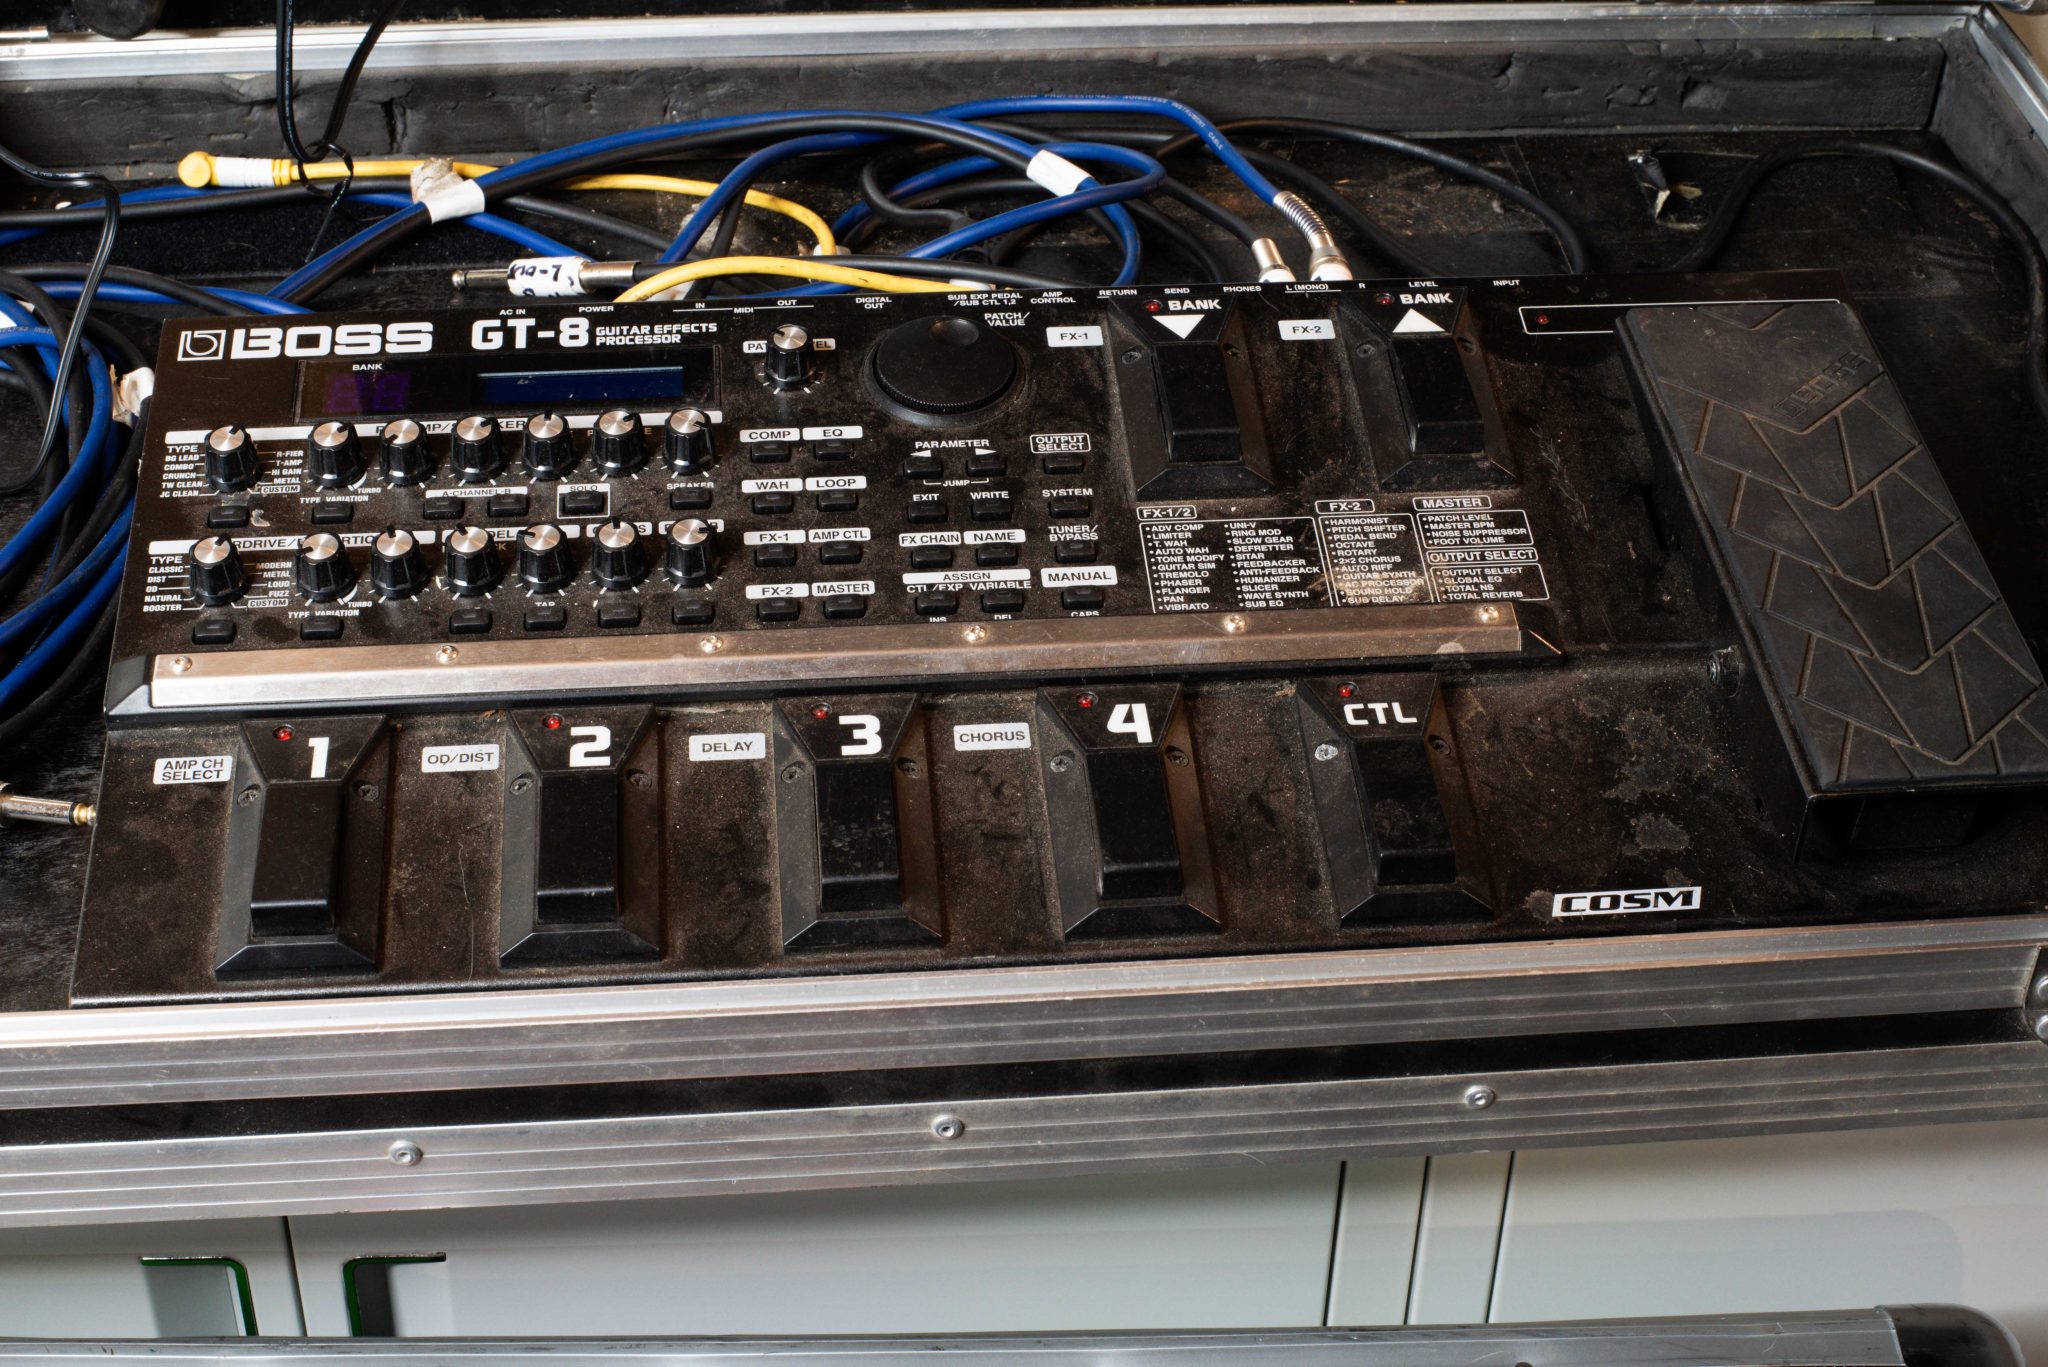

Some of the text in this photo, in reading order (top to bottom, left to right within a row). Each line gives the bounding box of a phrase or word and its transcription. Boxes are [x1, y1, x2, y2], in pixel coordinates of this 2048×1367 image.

[1207, 131, 1224, 150] CABLE
[1294, 283, 1329, 291] (MONO)
[1492, 279, 1520, 287] INPUT
[1099, 289, 1138, 297] RETURN
[1222, 285, 1262, 293] PHONES
[855, 296, 892, 304] DIGITAL
[991, 292, 1023, 300] PEDAL
[1399, 293, 1453, 305] BANK
[578, 305, 614, 313] POWER
[1167, 299, 1222, 311] BANK
[984, 312, 1030, 321] PATCH/
[987, 318, 1025, 326] VALUE
[471, 317, 590, 350] GT-8
[595, 322, 718, 337] GUITAR EFFECTS
[1292, 325, 1322, 335] FX-2
[231, 321, 434, 360] BOSS
[595, 334, 682, 346] PROCESSOR
[1060, 332, 1088, 341] FX-1
[352, 363, 383, 371] BANK
[748, 430, 791, 440] COMP
[822, 428, 843, 438] EQ
[915, 439, 990, 449] PARAMETER
[1035, 435, 1085, 444] OUTPUT
[167, 444, 199, 453] TYPE
[1037, 442, 1085, 451] SELECT
[276, 450, 304, 458] R-FIER
[164, 463, 194, 471] COMBO
[275, 459, 303, 467] T-AMP
[162, 472, 196, 480] CRUNCH
[273, 477, 301, 485] METAL
[666, 481, 714, 490] SPEAKER
[755, 481, 789, 490] WAH
[816, 478, 857, 488] LOOP
[942, 479, 970, 487] JUMP
[159, 489, 199, 498] JC CLEAN
[262, 485, 299, 494] CUSTOM
[1042, 488, 1093, 497] SYSTEM
[300, 494, 369, 504] TYPE VARIATION
[912, 493, 940, 501] EXIT
[970, 491, 1009, 500] WRITE
[1329, 502, 1361, 512] FX-2
[1422, 498, 1483, 509] MASTER
[1142, 508, 1192, 518] FX-1/2
[1428, 513, 1494, 522] PATCH LEVEL
[1330, 517, 1389, 526] HARMONIST
[1430, 521, 1495, 530] MASTER BPM
[1048, 524, 1099, 534] TUNER/
[1363, 524, 1406, 532] SHIFTER
[1462, 528, 1527, 536] SUPPRESSOR
[759, 533, 789, 542] FX-1
[812, 530, 867, 540] AMP CTL
[901, 534, 960, 545] FX CHAIN
[973, 531, 1016, 542] NAME
[1049, 532, 1099, 541] BYPASS
[1152, 532, 1192, 540] LIMITER
[1333, 532, 1397, 541] PEDAL BEND
[1232, 537, 1263, 545] SLOW
[1463, 536, 1505, 544] VOLUME
[1234, 544, 1294, 552] DEFRETTER
[1335, 541, 1375, 549] OCTAVE
[150, 555, 183, 565] TYPE
[1186, 554, 1225, 562] MODIFY
[1358, 555, 1402, 563] CHORUS
[1430, 550, 1535, 563] OUTPUT SELECT
[256, 561, 292, 569] MODERN
[1157, 563, 1196, 571] GUITAR
[1237, 559, 1306, 568] FEEDBACKER
[148, 566, 184, 574] CLASSIC
[262, 570, 291, 578] METAL
[1239, 566, 1321, 576] ANTI-FEEDBACK
[1442, 567, 1523, 577] OUTPUT SELECT
[147, 575, 166, 583] DIST
[942, 572, 991, 582] ASSIGN
[1047, 570, 1112, 582] MANUAL
[1159, 571, 1209, 579] TREMOLO
[1240, 575, 1300, 584] HUMANIZER
[267, 580, 291, 588] LOUD
[969, 580, 1032, 591] VARIABLE
[1160, 579, 1202, 587] PHASER
[145, 585, 158, 593] OD
[761, 586, 793, 596] FX-2
[817, 583, 870, 594] MASTER
[1161, 587, 1211, 595] FLANGER
[1241, 584, 1279, 592] SLICER
[144, 594, 182, 602] NATURAL
[1243, 592, 1272, 600] WAVE
[1447, 590, 1524, 600] TOTAL REVERB
[142, 603, 182, 612] BOOSTER
[249, 599, 288, 608] CUSTOM
[347, 600, 373, 608] TURBO
[1164, 603, 1209, 611] VIBRATO
[1343, 702, 1418, 726] CTL
[1106, 703, 1153, 744] 4
[838, 714, 883, 756] 3
[959, 730, 1025, 743] CHORUS
[569, 725, 611, 768] 2
[702, 741, 753, 753] DELAY
[308, 737, 330, 778] 1
[427, 752, 494, 765] OD/DIST
[163, 758, 224, 770] AMP CH
[162, 769, 223, 781] SELECT
[1560, 890, 1694, 913] COSM
